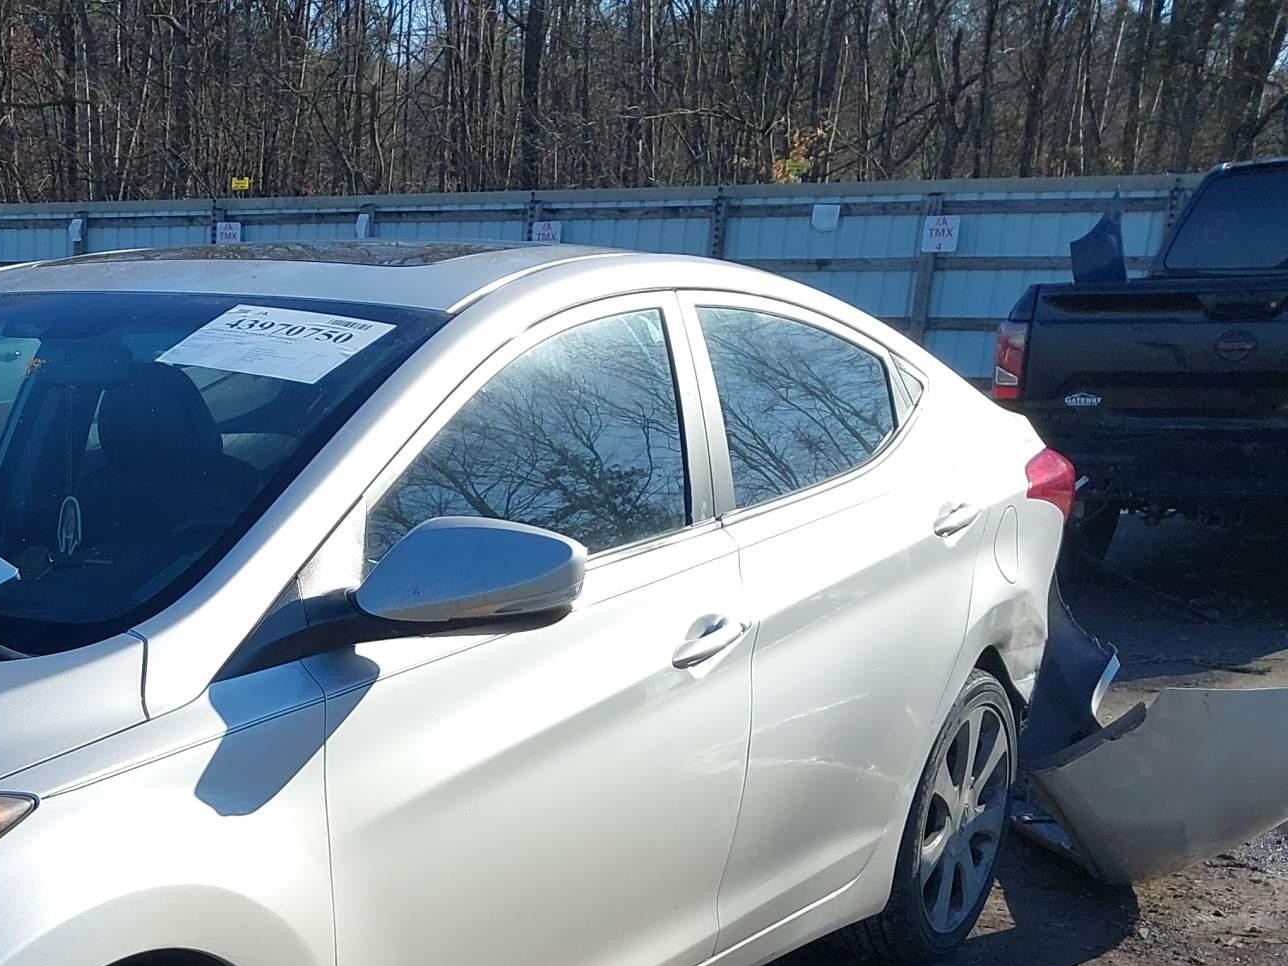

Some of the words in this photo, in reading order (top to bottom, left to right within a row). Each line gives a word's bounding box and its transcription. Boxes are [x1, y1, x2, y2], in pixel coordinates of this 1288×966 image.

[219, 231, 237, 240] TMX
[536, 232, 557, 241] TMX
[928, 227, 953, 238] TMX
[225, 318, 354, 344] 43970750
[1064, 395, 1103, 404] GATEWAY
